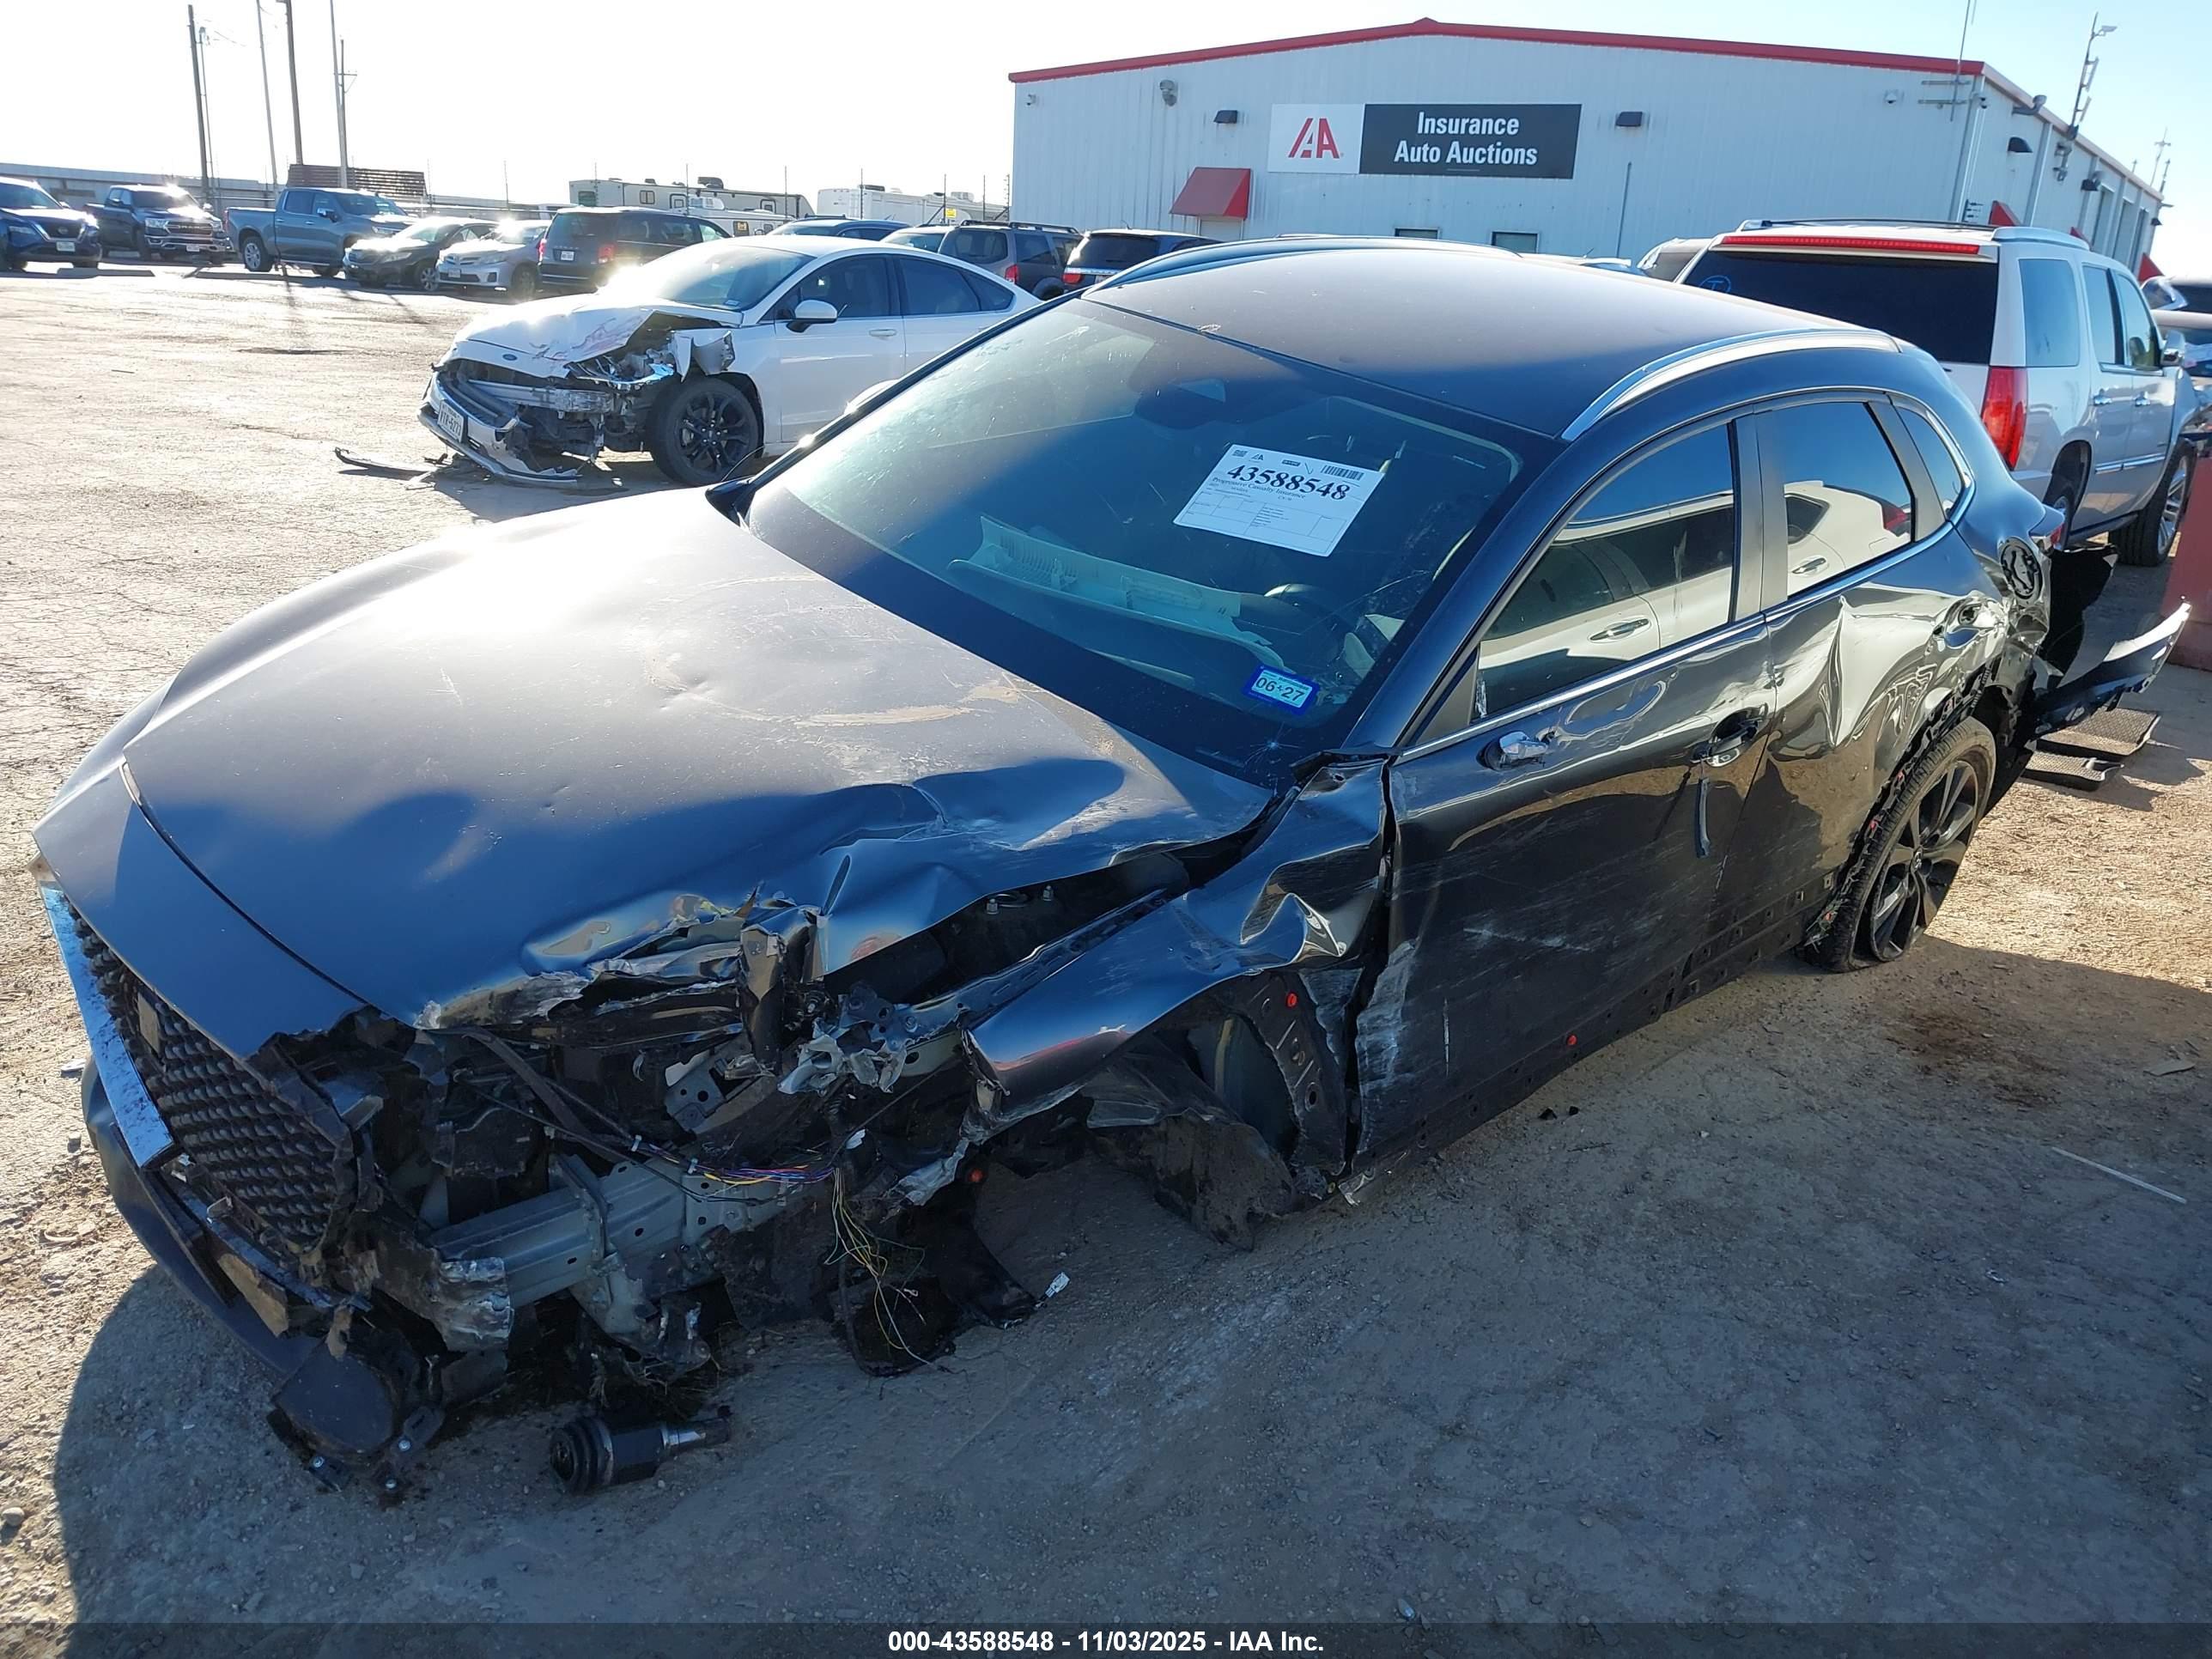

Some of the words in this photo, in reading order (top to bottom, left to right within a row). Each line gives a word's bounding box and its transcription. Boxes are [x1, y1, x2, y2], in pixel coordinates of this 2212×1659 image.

[1417, 112, 1520, 135] Insurance
[1394, 140, 1441, 163] Auto
[1445, 141, 1538, 165] Auctions
[1226, 465, 1351, 500] 43588548
[1249, 483, 1274, 493] Casualty
[1276, 489, 1305, 499] Insurance
[1255, 677, 1278, 692] 06
[1281, 686, 1305, 702] 27
